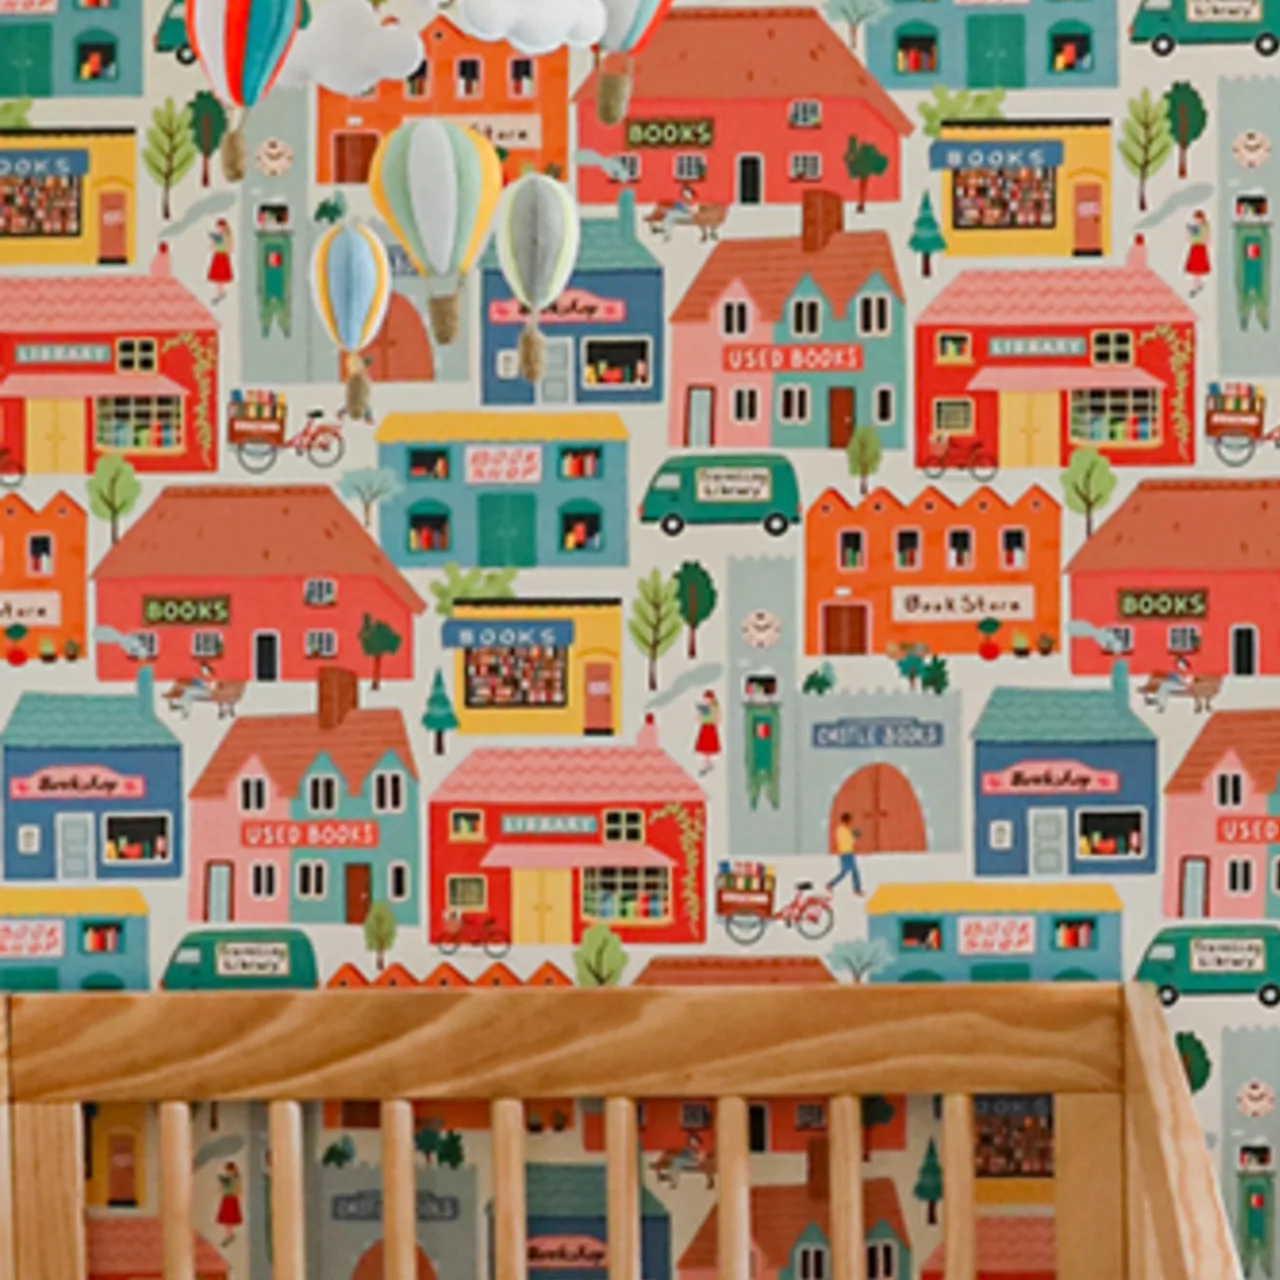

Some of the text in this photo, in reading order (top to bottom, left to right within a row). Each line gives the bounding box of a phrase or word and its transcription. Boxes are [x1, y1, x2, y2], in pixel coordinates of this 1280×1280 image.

[629, 123, 712, 141] BOOKS
[945, 150, 1044, 167] BOOKS
[19, 345, 106, 361] LIBRARY
[993, 338, 1080, 354] LIBRARY
[727, 345, 858, 369] USED BOOKS
[146, 601, 229, 619] BOOKS
[903, 594, 1022, 613] Book Store
[1122, 594, 1205, 612] BOOKS
[457, 628, 556, 645] BOOKS
[244, 821, 375, 845] USED BOOKS
[505, 816, 592, 832] LIBRARY
[1221, 818, 1280, 841] USED
